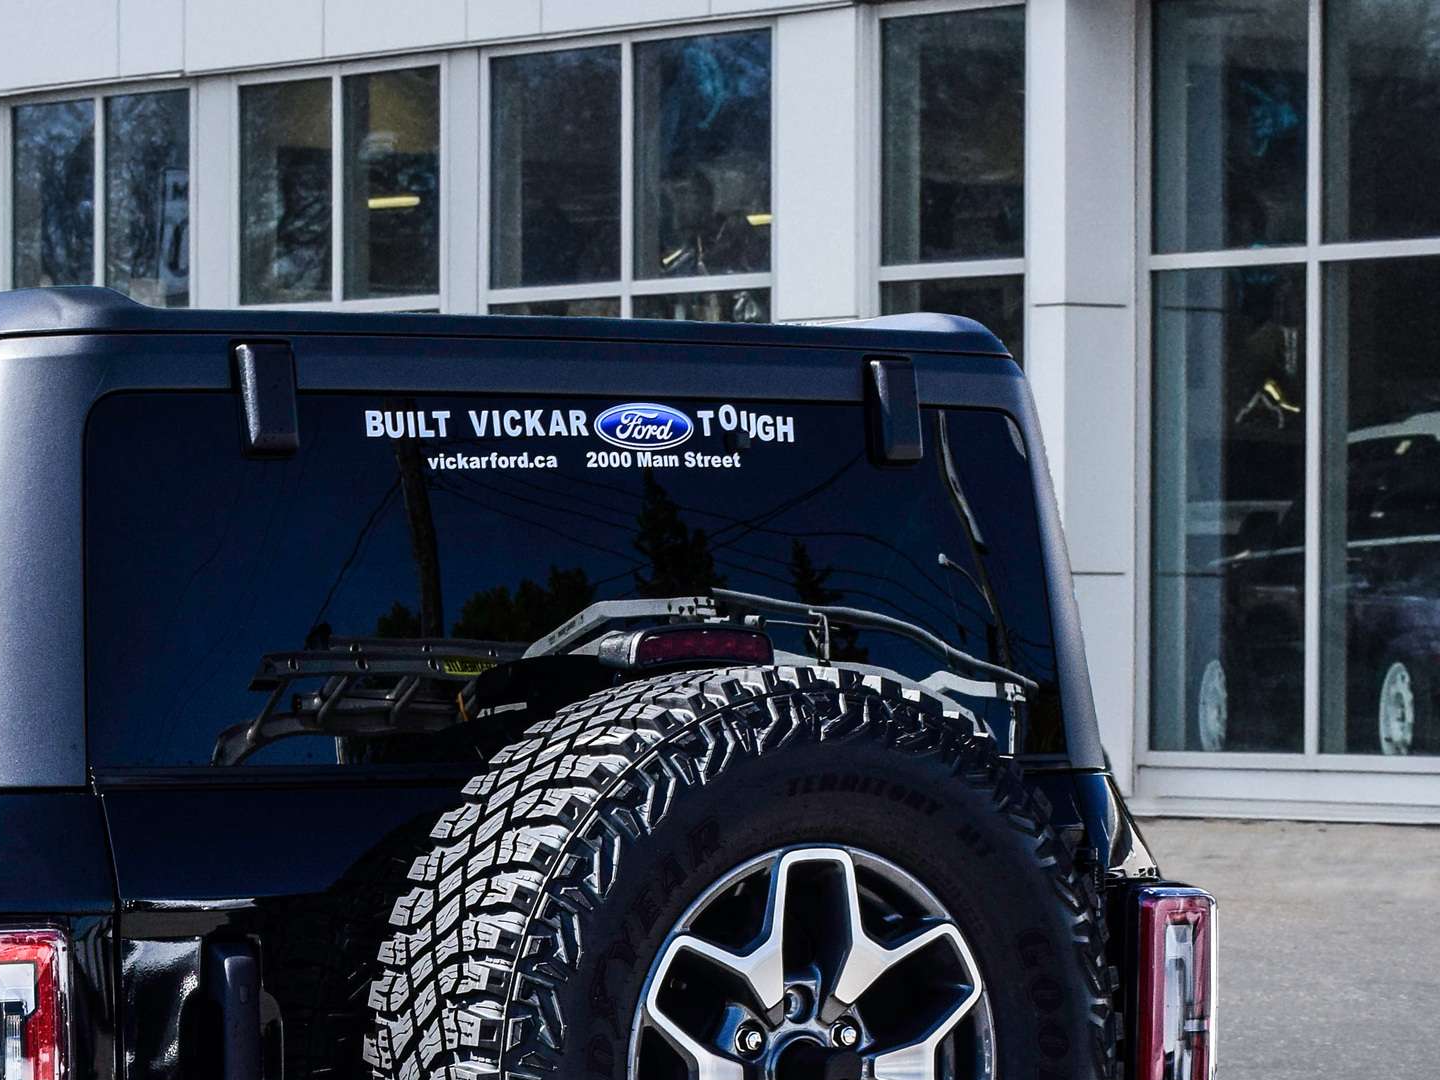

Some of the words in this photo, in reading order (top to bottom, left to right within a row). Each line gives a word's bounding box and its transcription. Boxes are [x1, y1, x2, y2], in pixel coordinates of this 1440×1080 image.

[364, 410, 451, 438] BUILT
[468, 409, 589, 438] VICKAR
[696, 403, 795, 443] TOUGH
[427, 452, 558, 470] vickarford.ca
[586, 451, 632, 468] 2000
[636, 451, 679, 468] Main
[684, 451, 741, 468] Street
